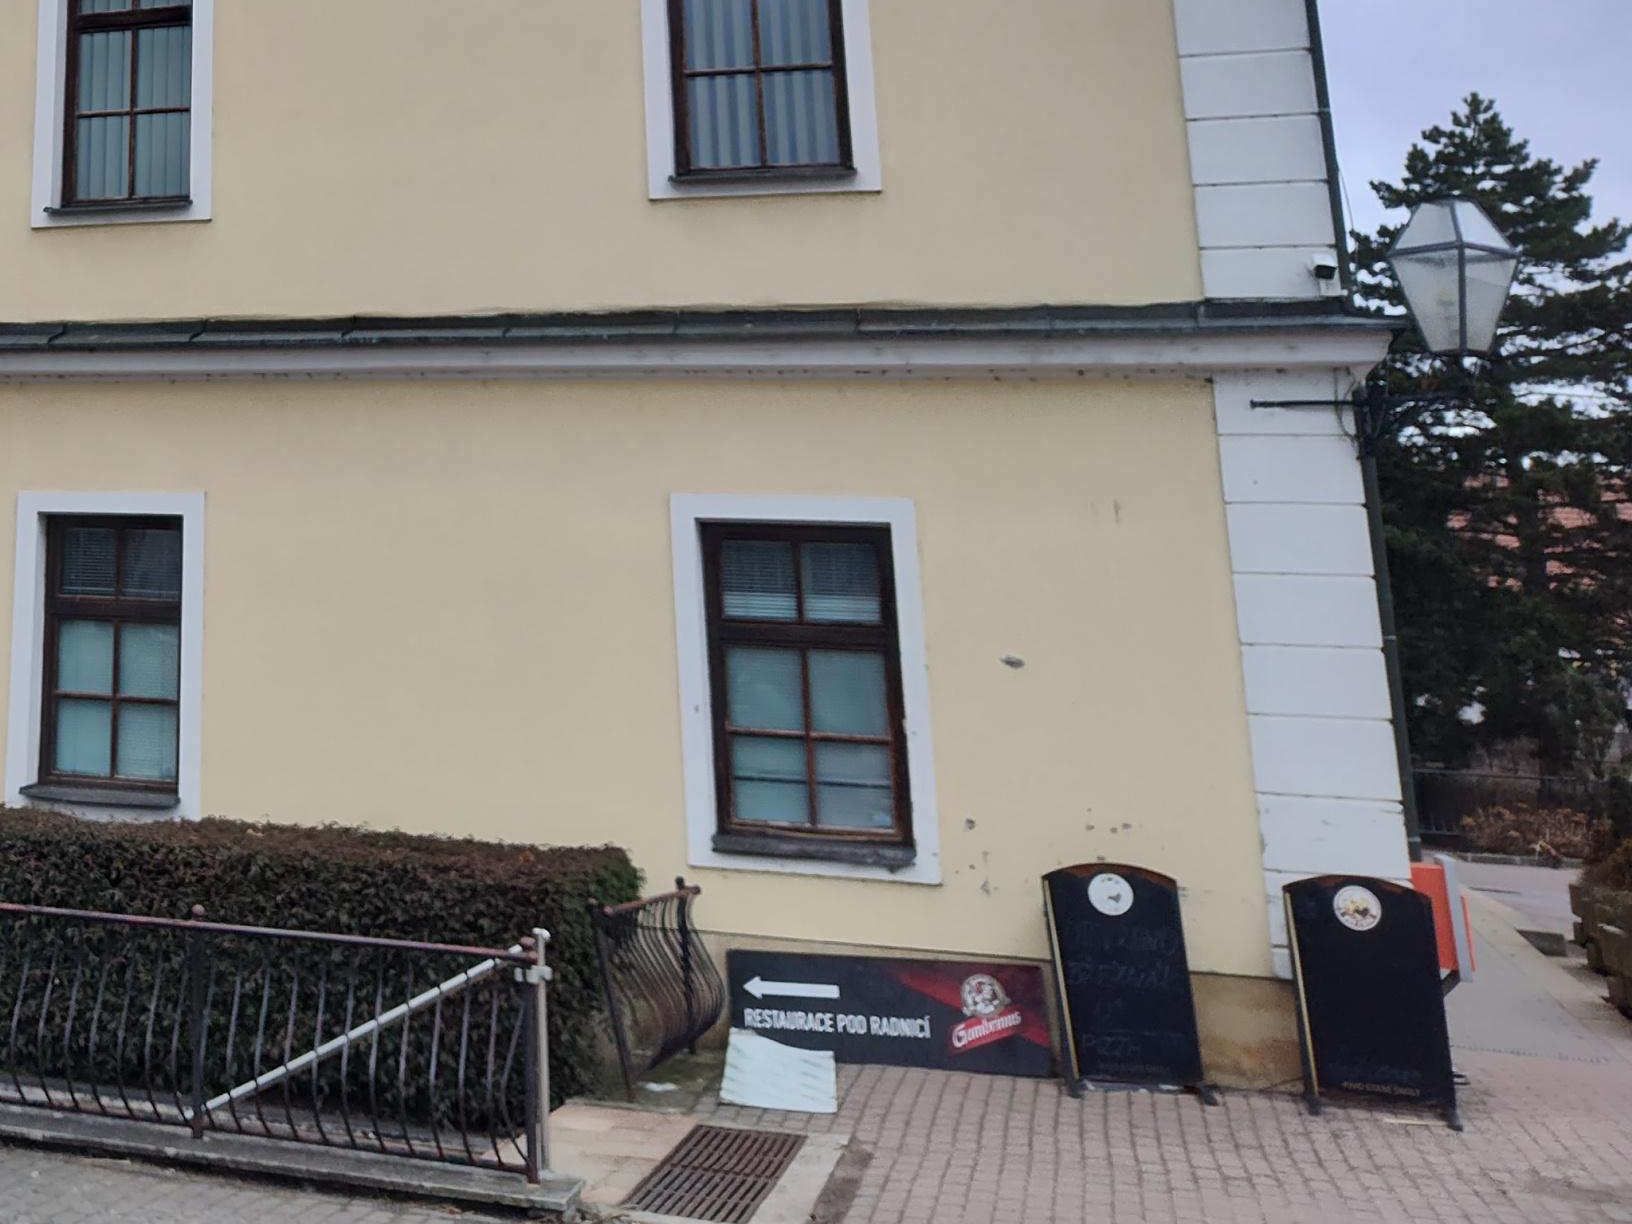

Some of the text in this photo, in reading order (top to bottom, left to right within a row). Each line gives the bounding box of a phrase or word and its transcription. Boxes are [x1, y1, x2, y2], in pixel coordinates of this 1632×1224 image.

[743, 1007, 931, 1039] RESTAURACE POD RADNICÍ
[952, 1011, 1022, 1048] Gambrinus
